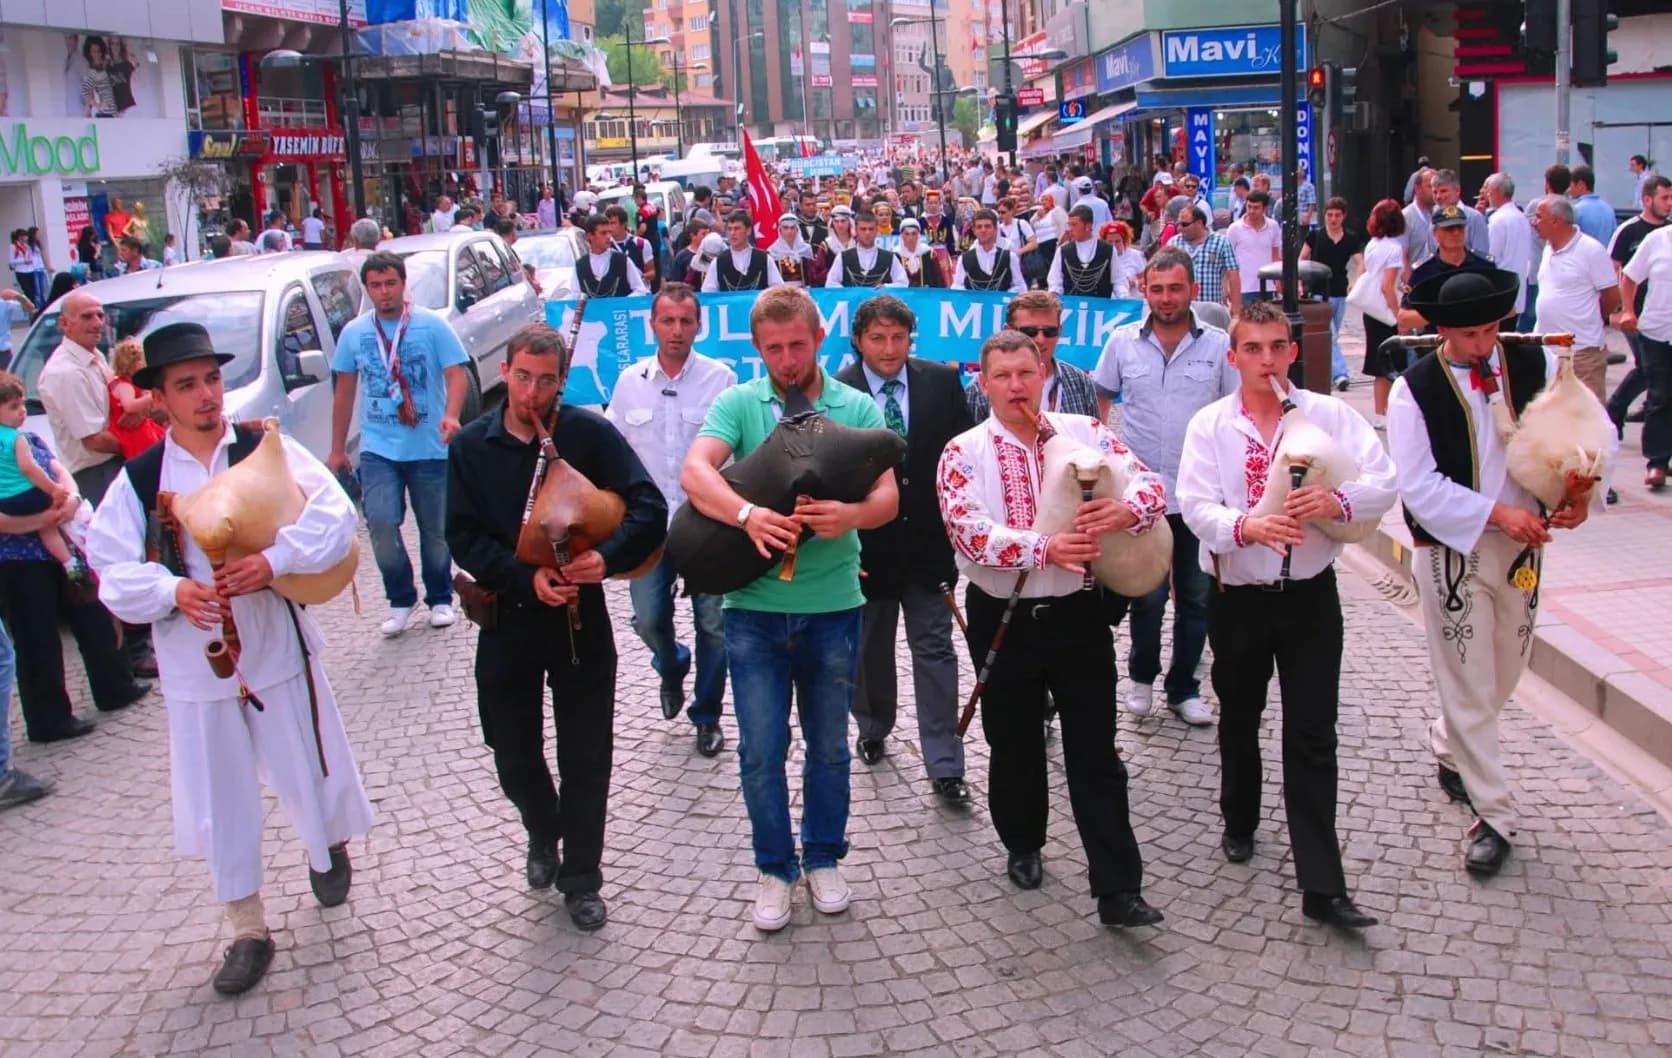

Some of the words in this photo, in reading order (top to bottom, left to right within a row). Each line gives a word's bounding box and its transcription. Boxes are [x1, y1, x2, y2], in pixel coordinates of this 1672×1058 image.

[1167, 32, 1257, 63] Mavi
[0, 122, 100, 175] Mood
[272, 133, 319, 156] YASEMİN
